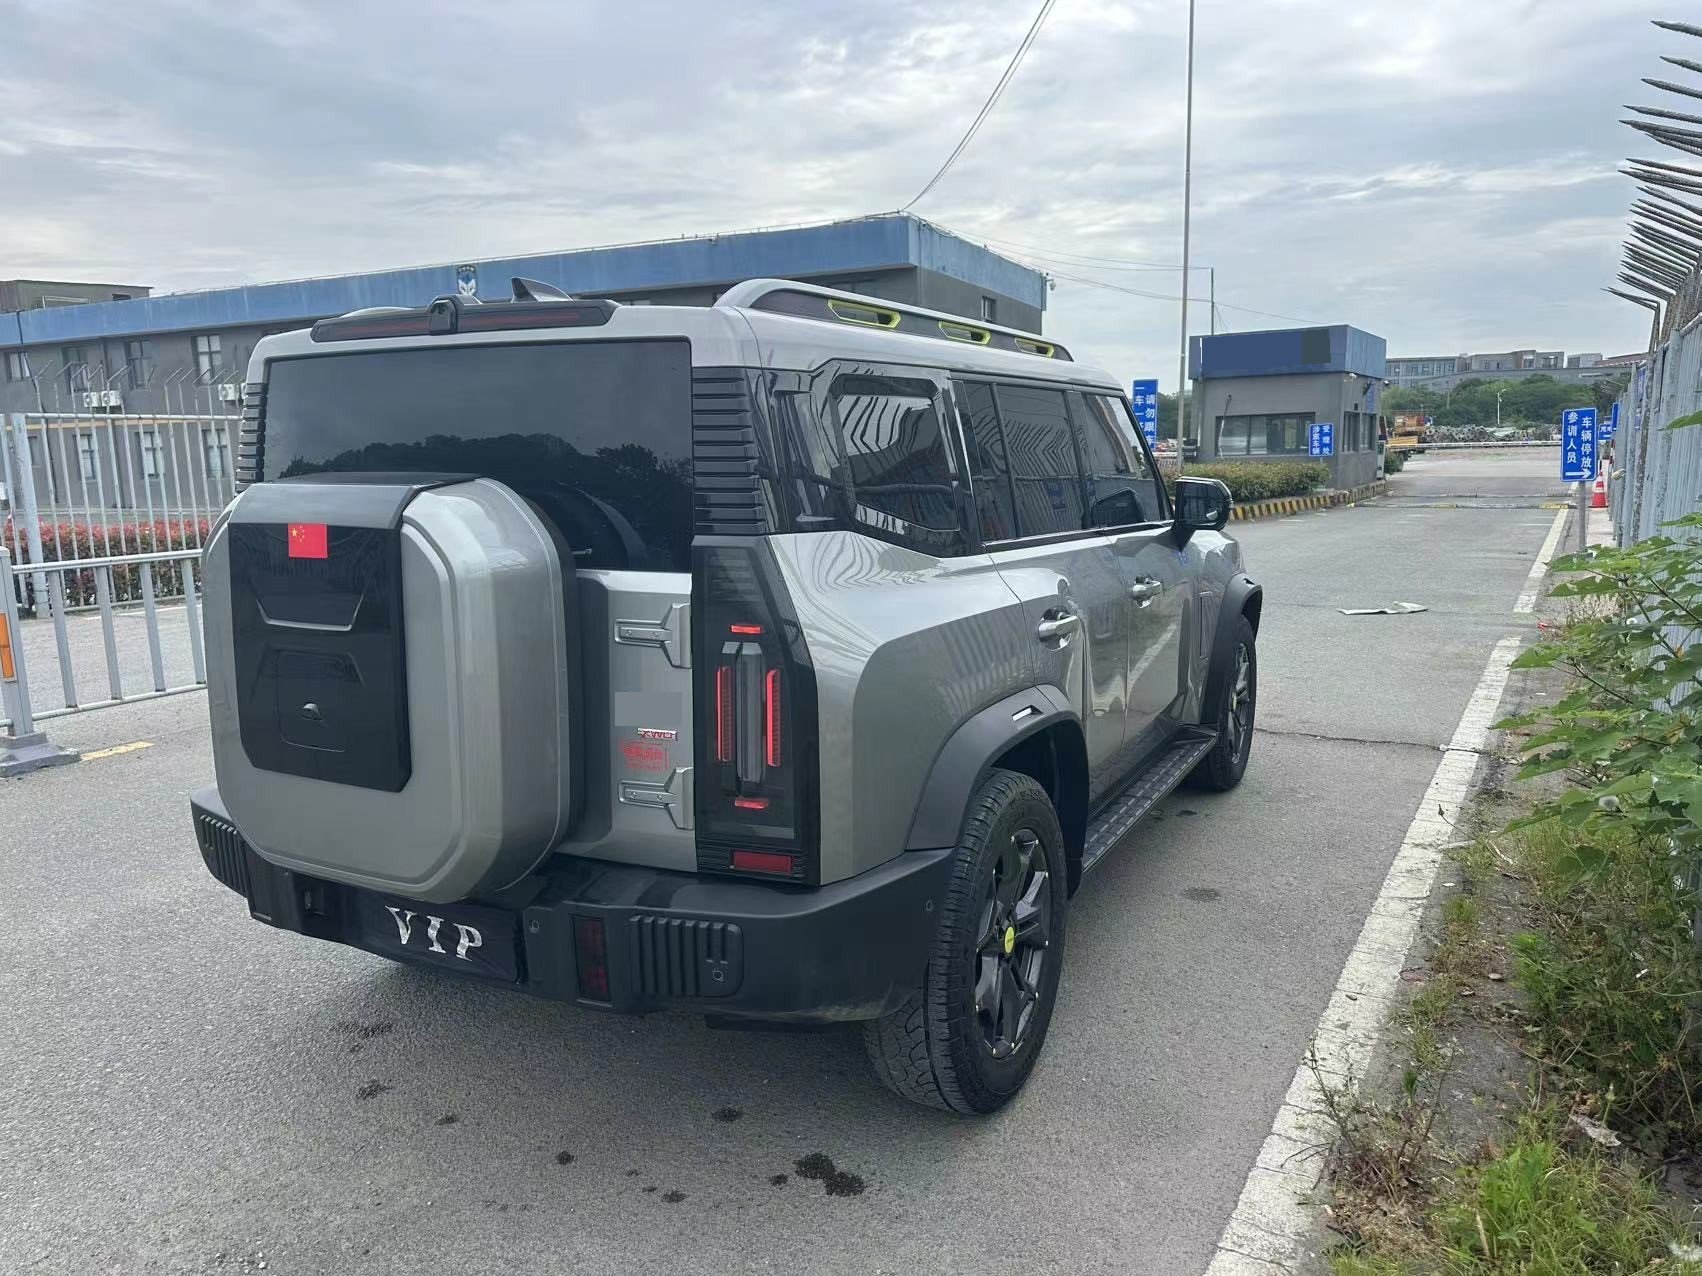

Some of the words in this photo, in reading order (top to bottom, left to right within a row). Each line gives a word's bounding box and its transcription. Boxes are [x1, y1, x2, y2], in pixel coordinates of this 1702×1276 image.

[1145, 394, 1155, 446] 请勿跟车
[1567, 411, 1578, 464] 参训人员
[1580, 416, 1592, 468] 车辆停放
[385, 905, 483, 962] VIP
